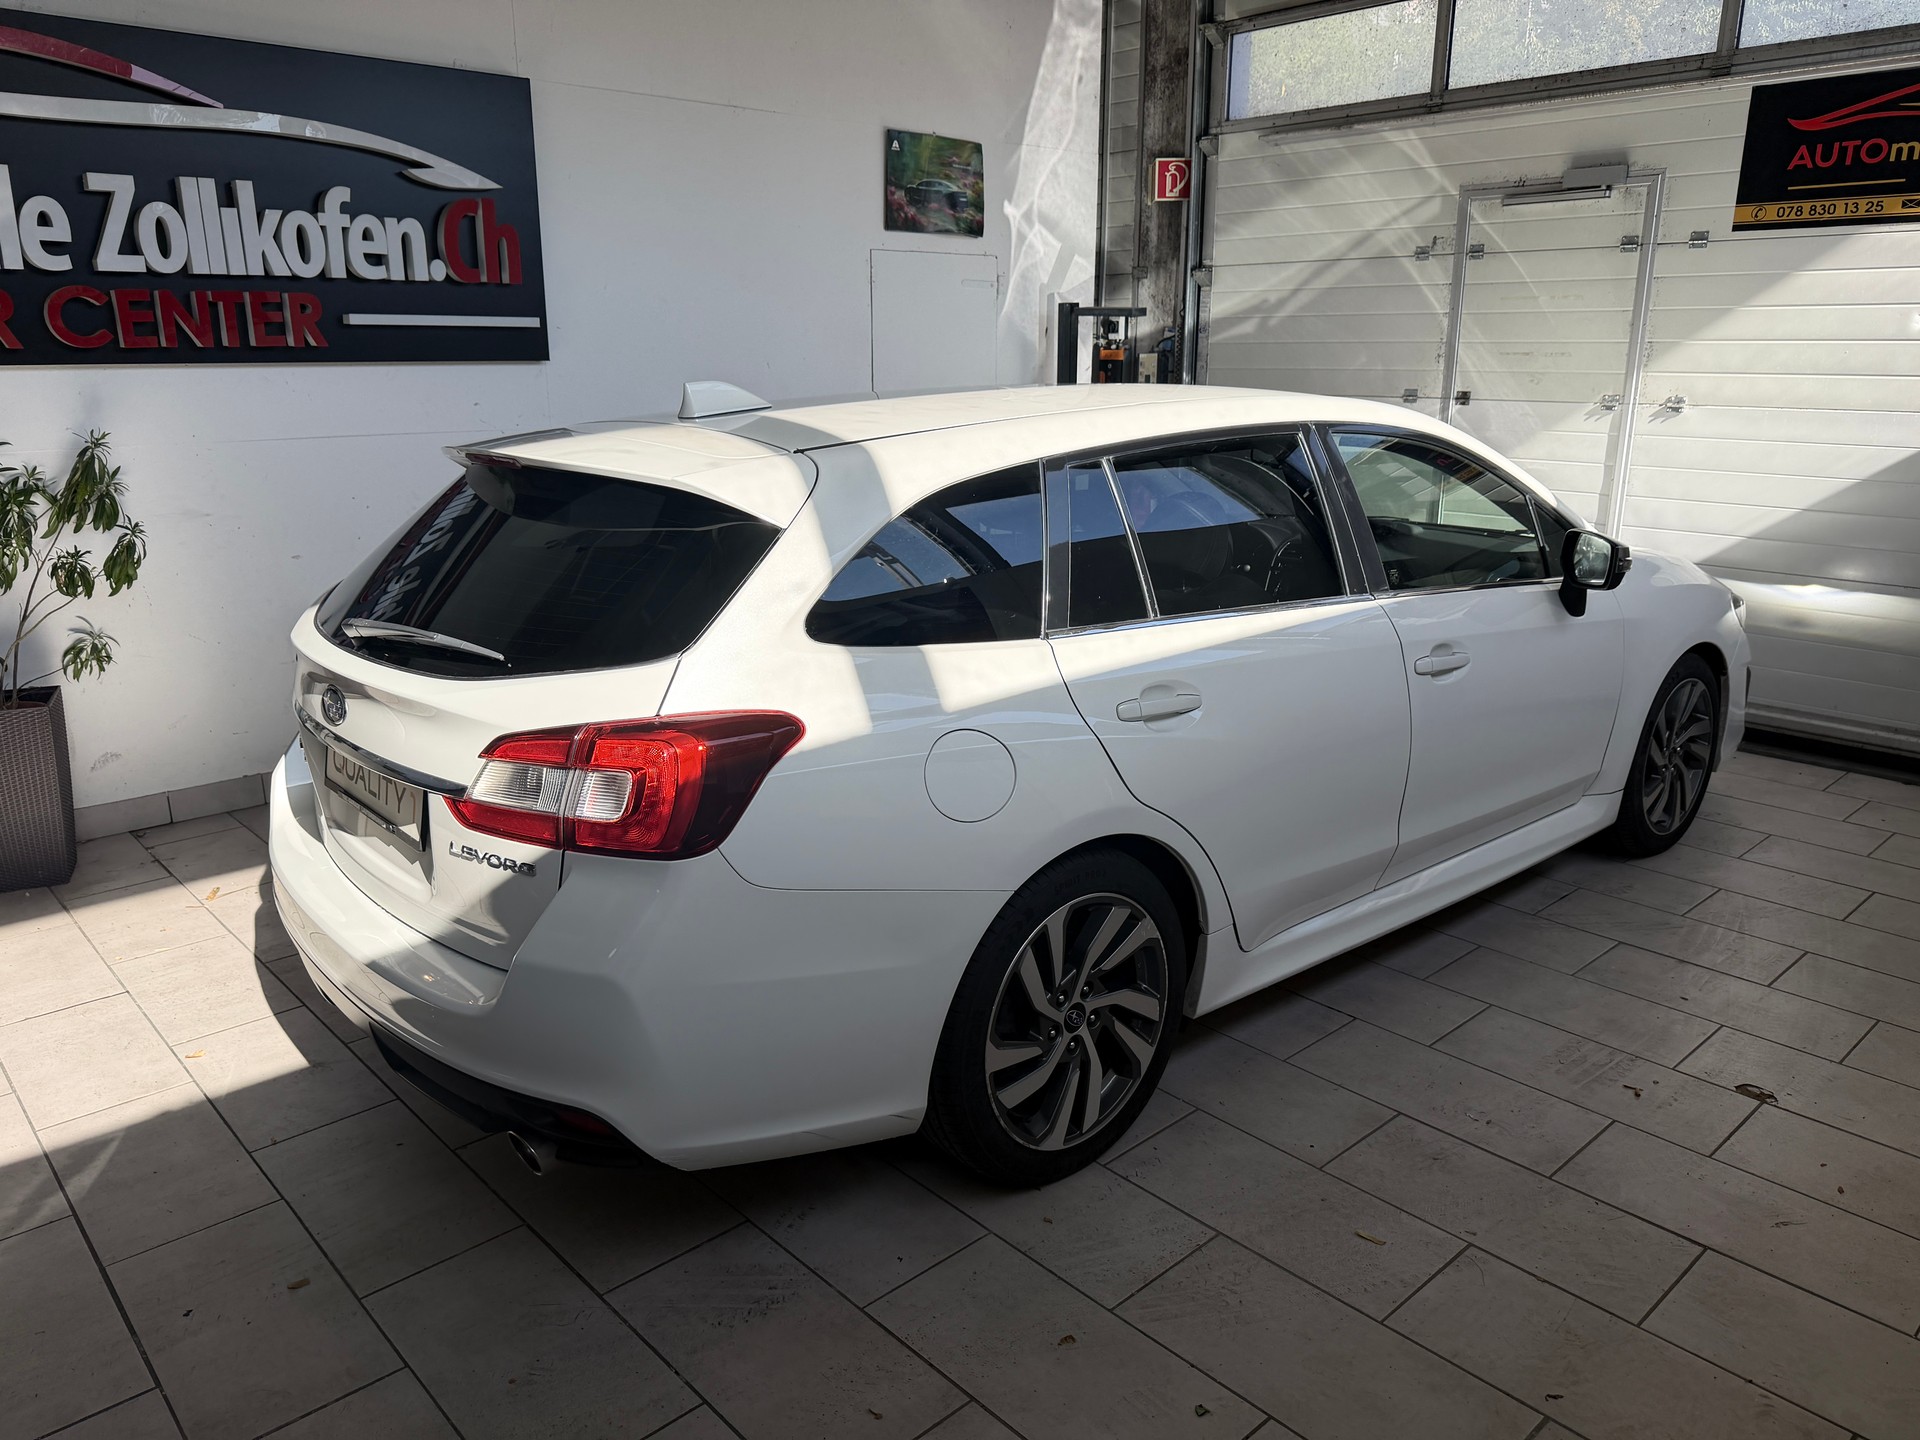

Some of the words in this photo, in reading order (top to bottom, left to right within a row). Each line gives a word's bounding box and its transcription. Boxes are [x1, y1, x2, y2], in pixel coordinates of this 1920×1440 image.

[83, 172, 522, 285] Zollikofen.Ch
[1776, 205, 1804, 218] 078
[1808, 203, 1837, 216] 830
[1843, 202, 1859, 214] 13
[1864, 200, 1884, 213] 25
[43, 285, 329, 349] CENTER
[333, 750, 407, 814] QUALITY
[449, 840, 536, 877] LEVORG
